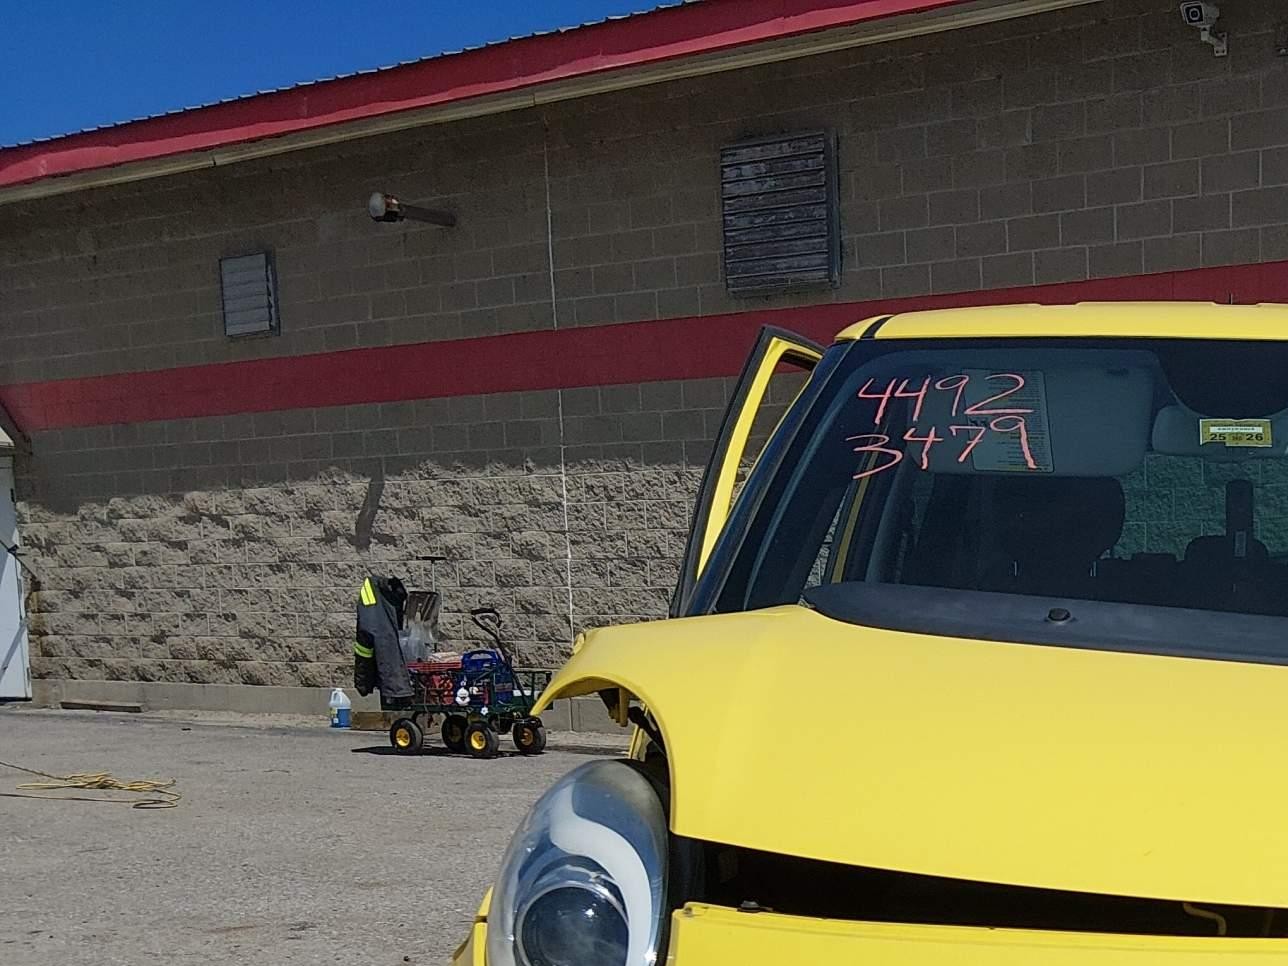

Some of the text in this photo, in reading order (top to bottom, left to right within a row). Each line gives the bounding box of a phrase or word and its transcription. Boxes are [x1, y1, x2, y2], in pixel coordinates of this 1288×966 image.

[858, 373, 1034, 425] 4492
[846, 415, 1037, 480] 3479
[1210, 433, 1226, 441] 25
[1246, 433, 1263, 441] 26
